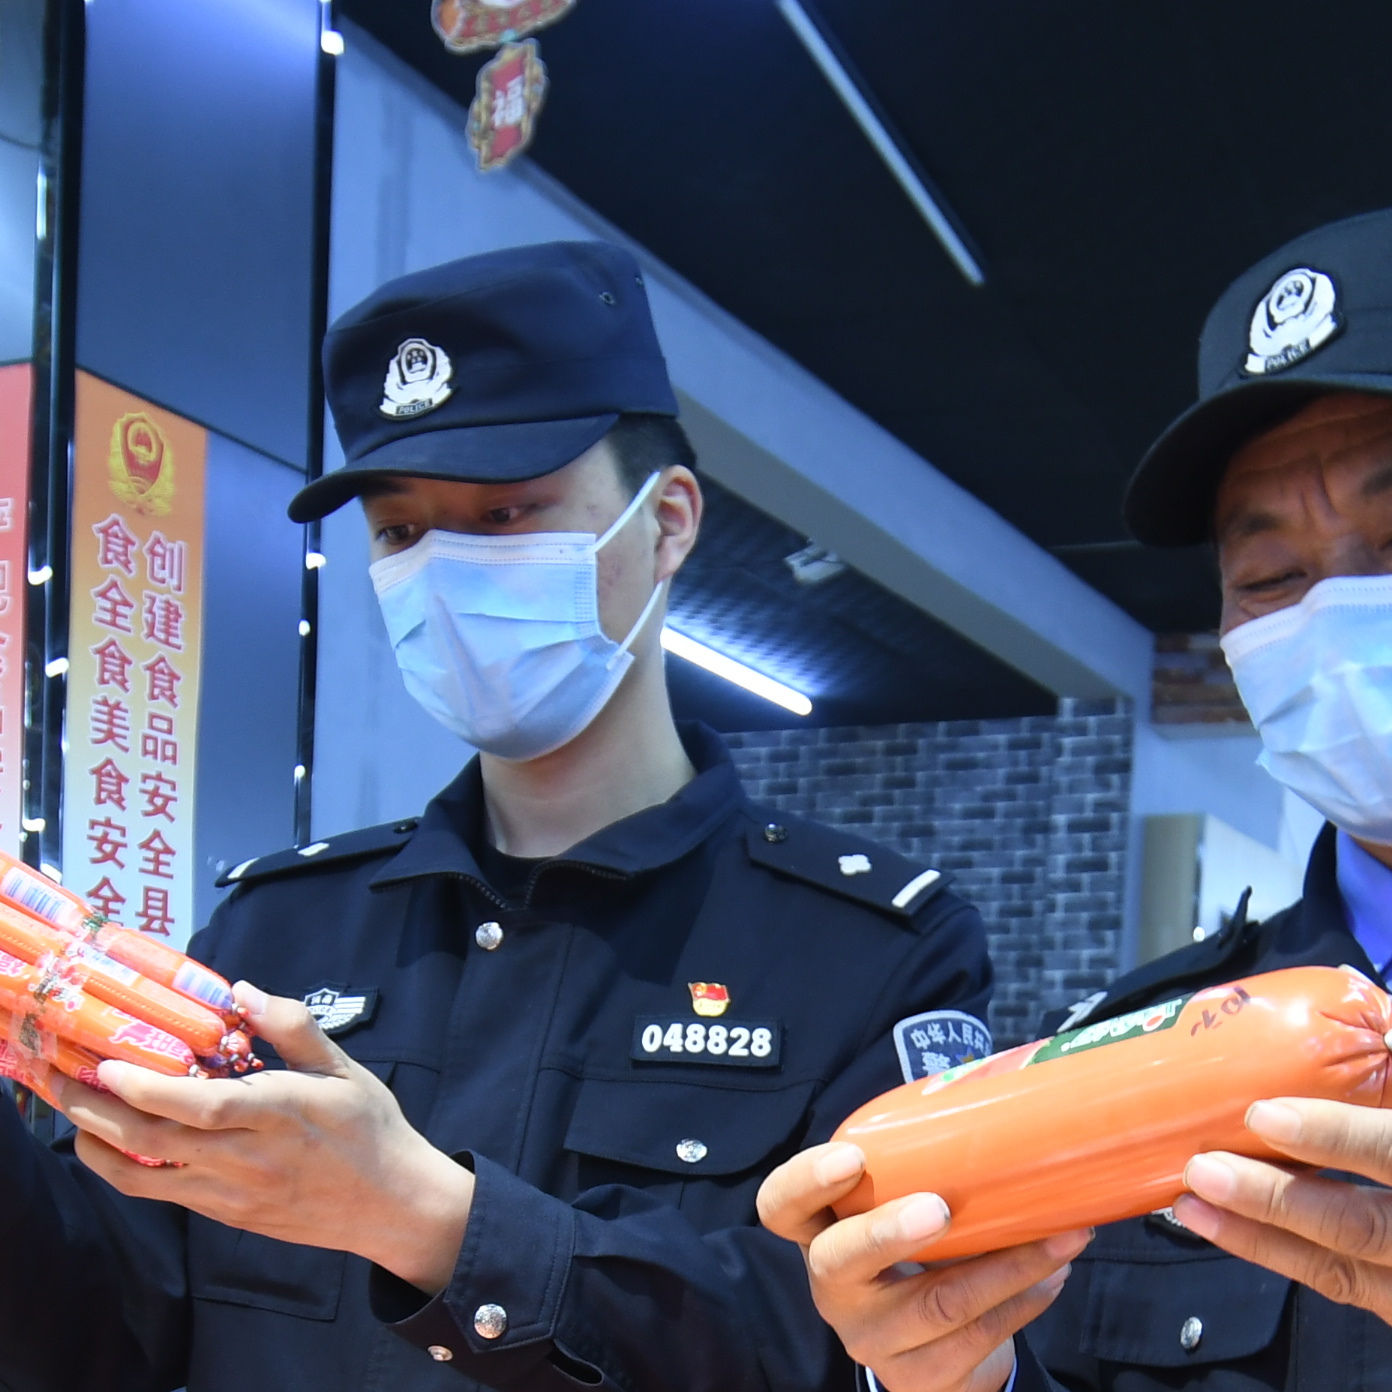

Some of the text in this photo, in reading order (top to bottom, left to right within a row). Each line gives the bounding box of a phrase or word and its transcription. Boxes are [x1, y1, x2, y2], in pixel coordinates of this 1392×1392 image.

[135, 530, 187, 937] 创建食品安全县
[641, 1023, 773, 1059] 048828
